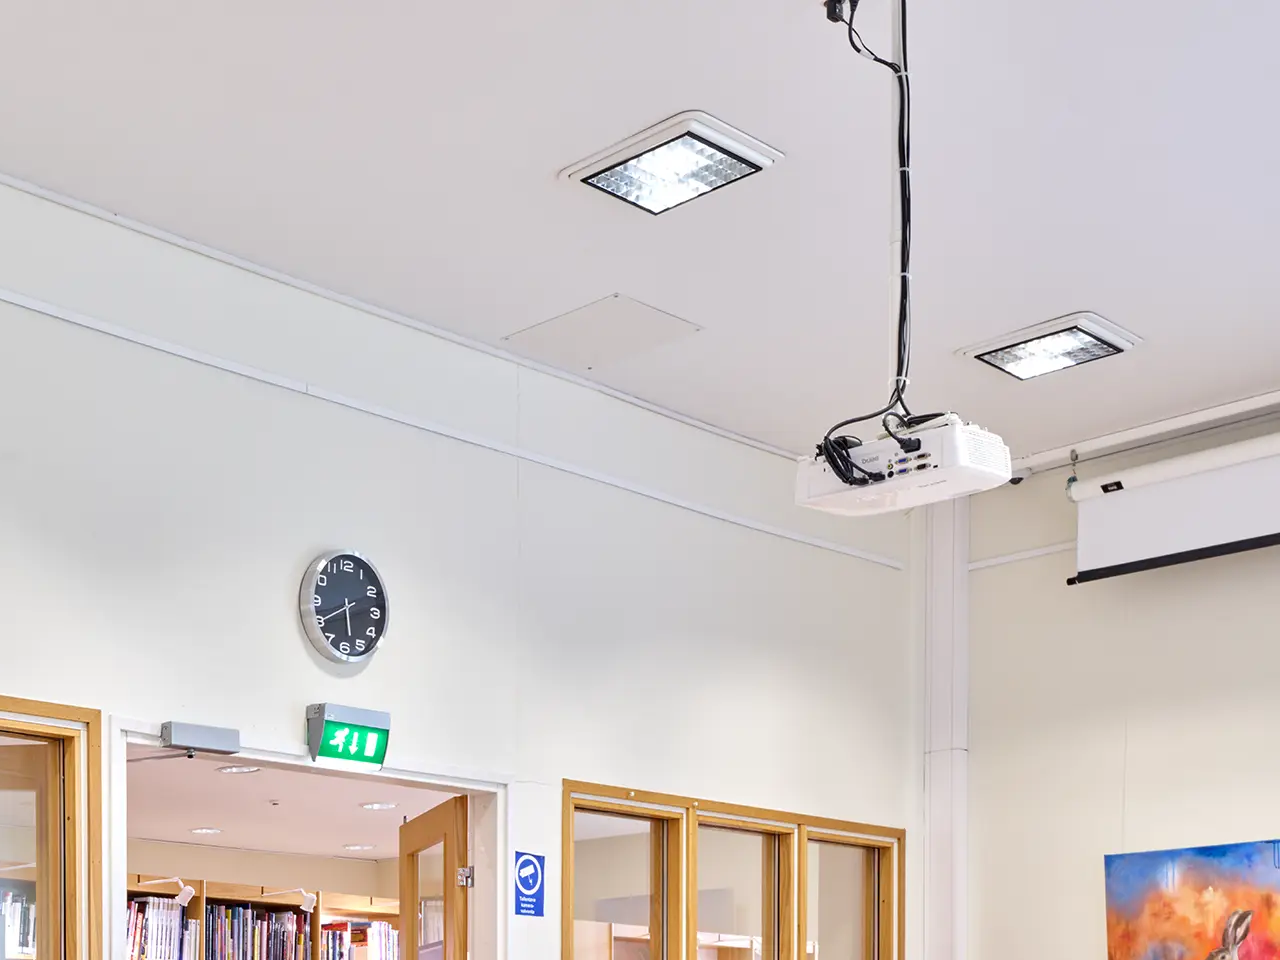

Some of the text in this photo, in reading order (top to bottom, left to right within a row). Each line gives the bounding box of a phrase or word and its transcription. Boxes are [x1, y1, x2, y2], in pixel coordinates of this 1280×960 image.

[327, 561, 337, 574] 11
[340, 559, 354, 573] 12
[360, 569, 363, 580] 1
[366, 586, 377, 598] 2
[313, 594, 322, 607] 9
[369, 607, 381, 619] 3
[324, 632, 336, 644] 7
[366, 626, 376, 639] 4
[339, 641, 350, 654] 6
[355, 639, 366, 651] 5
